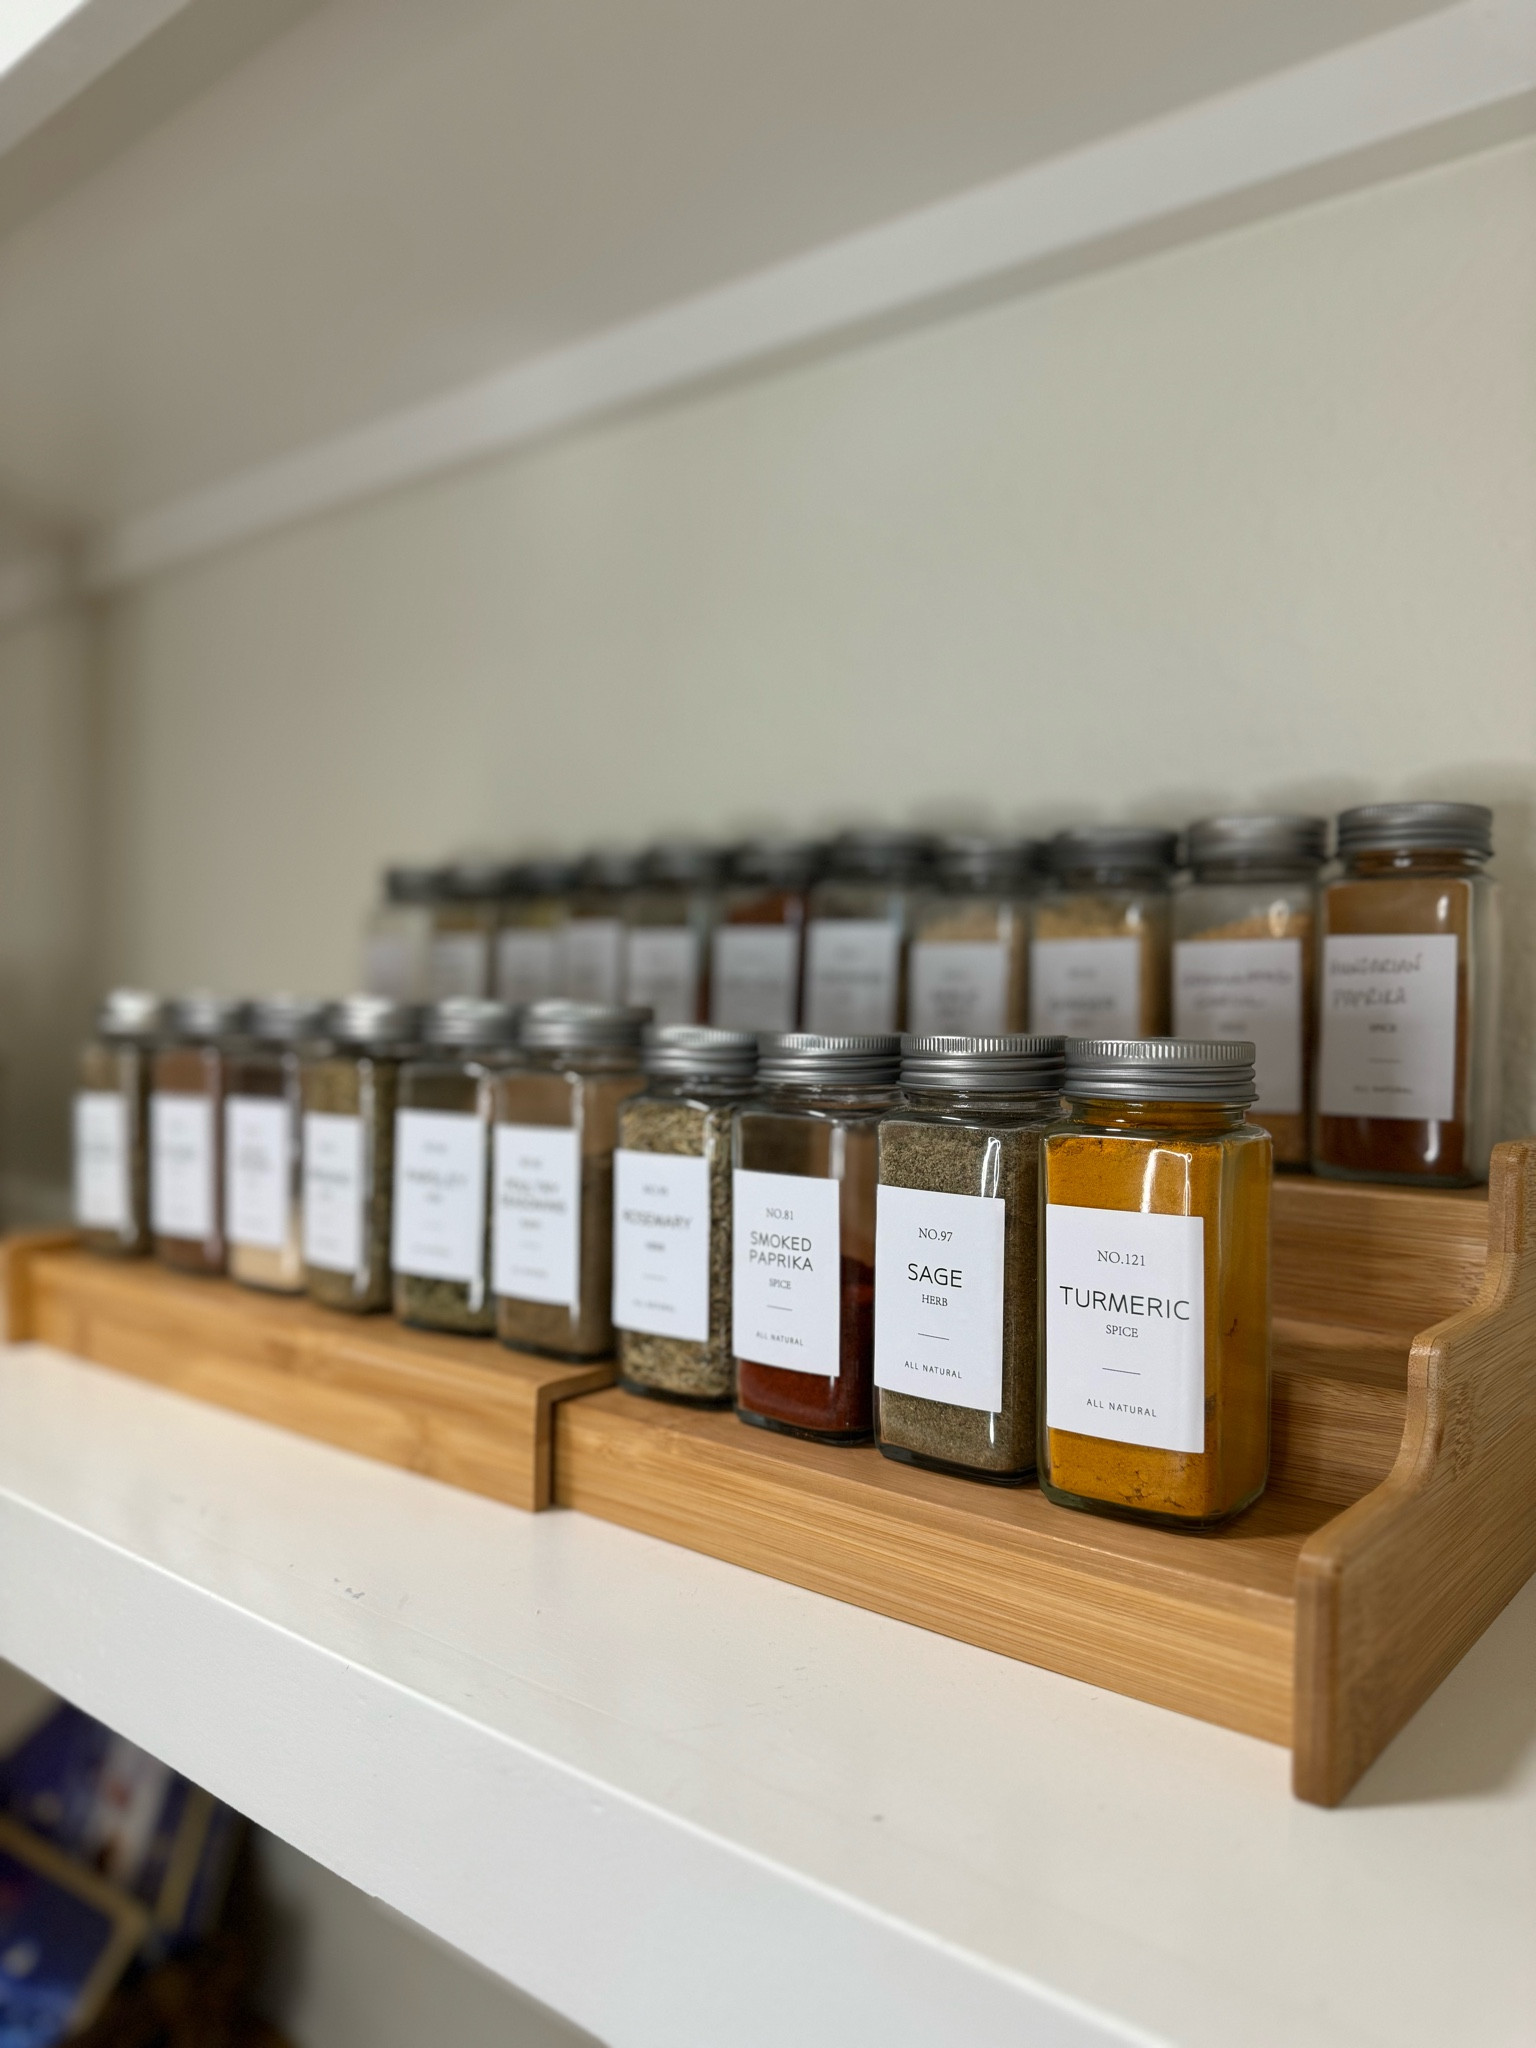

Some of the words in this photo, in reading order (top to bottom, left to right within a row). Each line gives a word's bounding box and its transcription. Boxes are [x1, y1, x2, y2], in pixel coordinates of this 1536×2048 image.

[765, 1207, 794, 1221] NO.81
[749, 1230, 813, 1253] SMOKED
[918, 1226, 954, 1243] NO.97
[748, 1248, 814, 1273] PAPRIKA
[1096, 1249, 1146, 1267] NO.121
[768, 1277, 792, 1291] SPICE
[907, 1262, 963, 1289] SAGE
[921, 1293, 949, 1307] HERB
[1058, 1285, 1191, 1321] TURMERIC
[770, 1333, 804, 1347] NATURAL
[1105, 1323, 1139, 1339] SPICE
[904, 1360, 919, 1371] ALL
[922, 1363, 963, 1380] NATURAL
[1086, 1398, 1105, 1409] ALL
[1108, 1401, 1157, 1418] NATURAL
